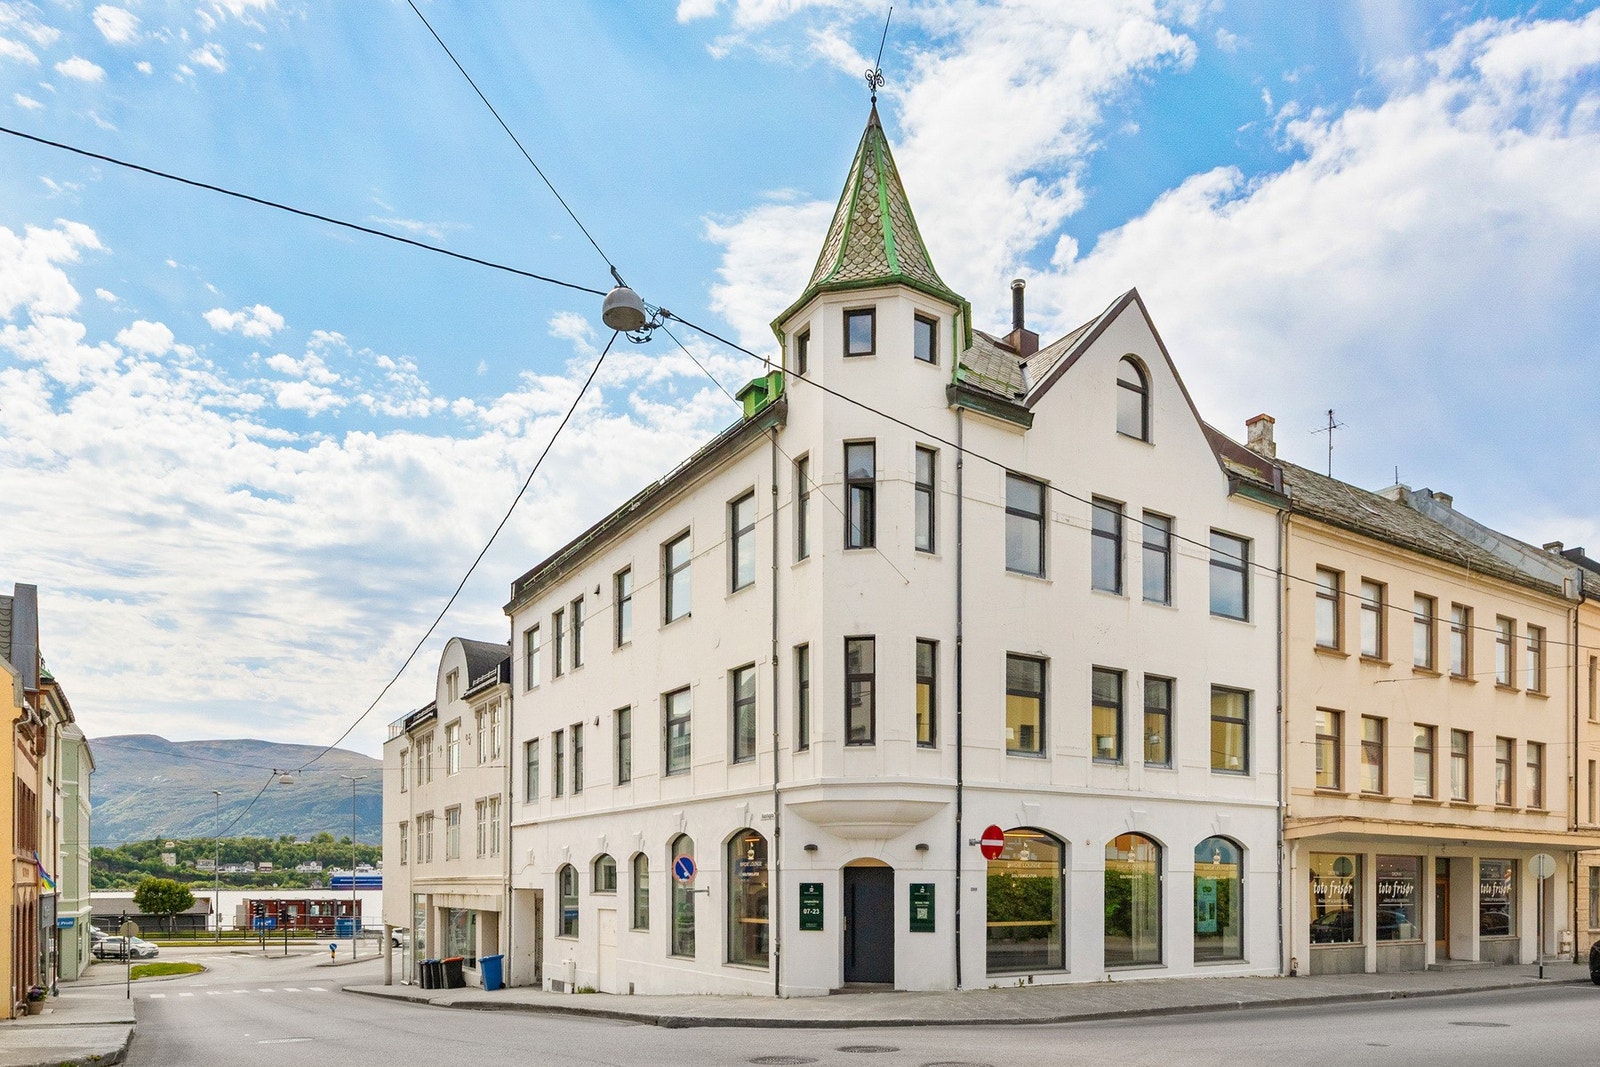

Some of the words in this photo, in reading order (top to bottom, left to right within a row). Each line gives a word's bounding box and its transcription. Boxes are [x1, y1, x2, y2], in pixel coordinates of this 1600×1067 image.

[1313, 881, 1328, 894] toto
[1328, 880, 1353, 898] frisør
[1378, 882, 1392, 894] toto
[1392, 880, 1414, 898] frisør
[1480, 882, 1491, 894] toto
